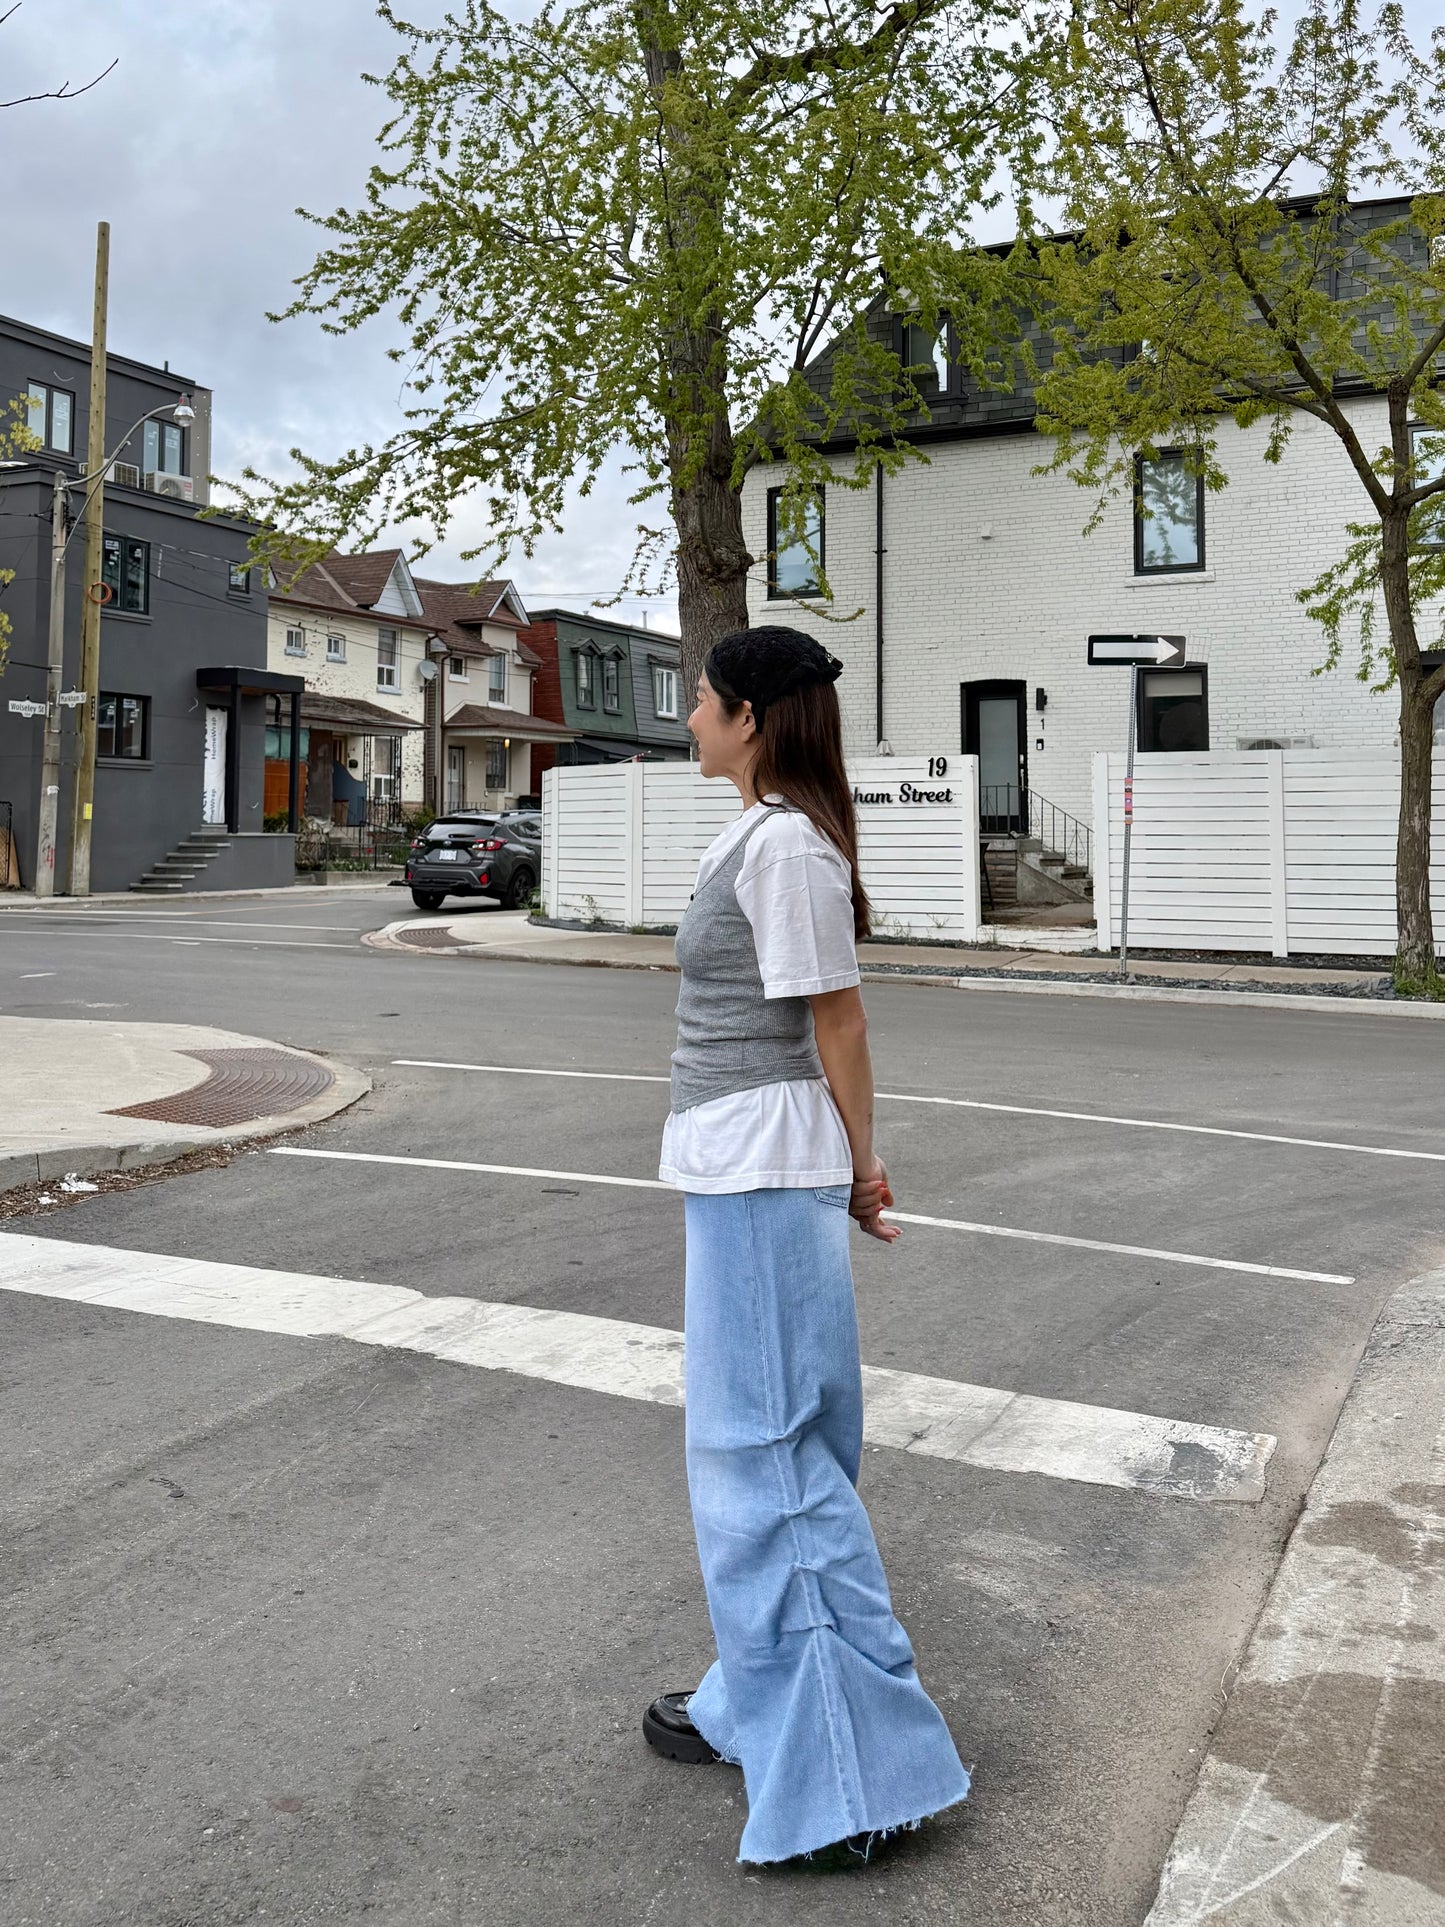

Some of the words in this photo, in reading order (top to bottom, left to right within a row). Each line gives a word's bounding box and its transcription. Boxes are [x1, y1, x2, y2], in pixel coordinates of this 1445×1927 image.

[10, 703, 37, 713] Wolseley
[38, 705, 44, 713] St
[927, 757, 948, 777] 19
[853, 786, 894, 804] ham
[899, 783, 954, 803] Street
